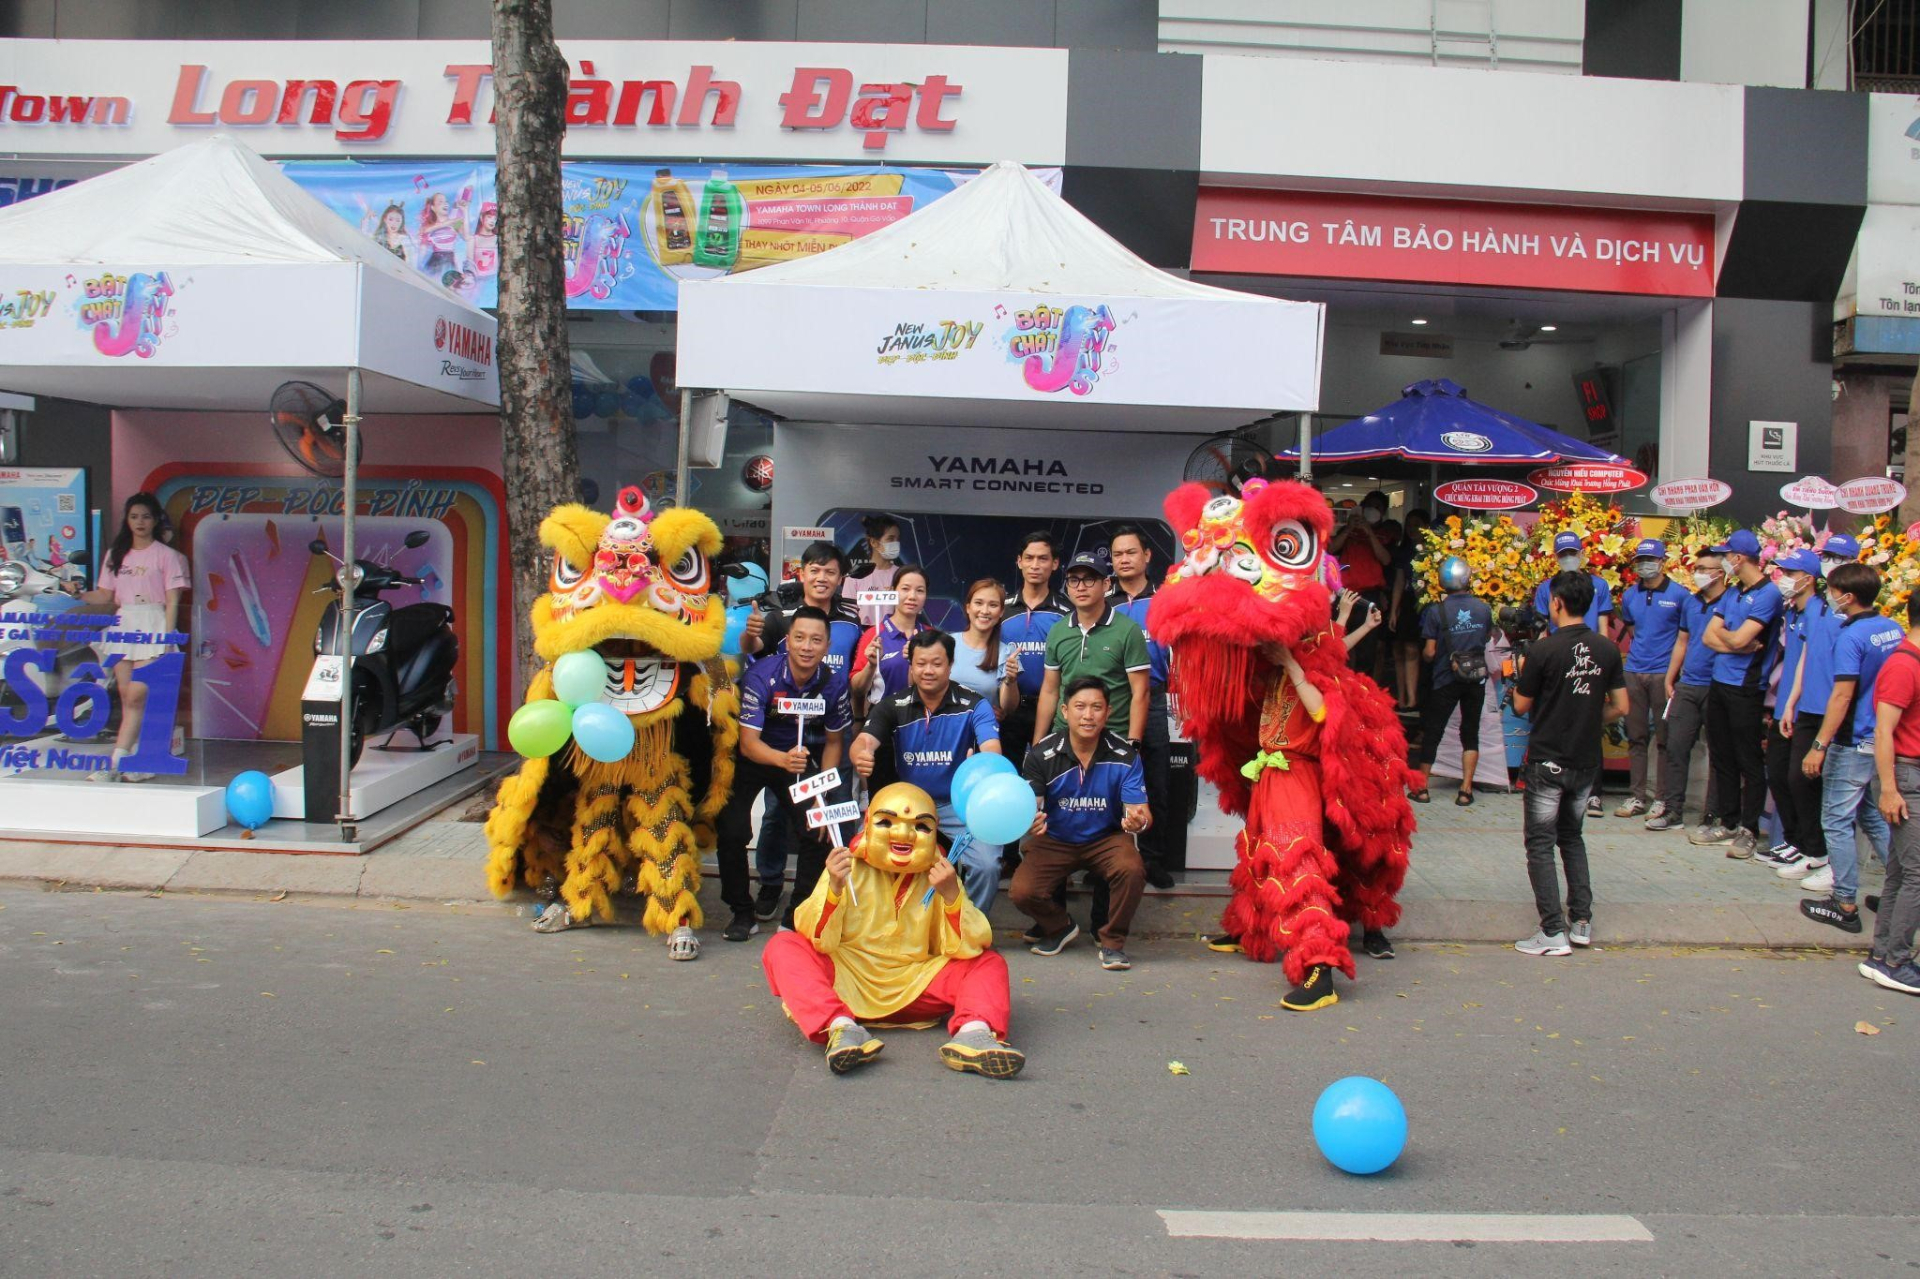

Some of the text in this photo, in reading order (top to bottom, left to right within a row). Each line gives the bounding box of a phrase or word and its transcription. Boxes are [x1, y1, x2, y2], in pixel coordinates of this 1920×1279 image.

[166, 64, 401, 142] Long
[444, 58, 743, 127] Tành
[779, 66, 963, 149] Đạt
[756, 181, 872, 195] NGÀY 04-05/06/2022
[756, 206, 794, 214] YAMAHA
[796, 204, 821, 213] TOWN
[823, 203, 848, 212] LONG
[745, 240, 768, 249] THAY
[1210, 217, 1704, 271] TRUNG TÂM BẢO HÀNH VÀ DỊCH VỤ
[1879, 298, 1900, 311] Tôn
[877, 319, 985, 354] JANUS JOY
[895, 323, 924, 336] NEW
[448, 321, 491, 366] YAMAHA
[928, 455, 1068, 477] YAMAHA
[1590, 470, 1624, 478] COMPUTER
[890, 477, 1104, 494] SMART CONNECTED
[798, 530, 826, 538] YAMAHA
[8, 629, 30, 640] GA
[106, 629, 152, 644] NHIÊN
[1017, 641, 1046, 651] YAMAH
[793, 702, 824, 711] YAMAHA
[118, 653, 188, 775] 1
[312, 714, 338, 722] YAMAHA
[46, 748, 112, 771] Nam
[915, 751, 953, 762] YAMAHA
[812, 772, 836, 788] LTD
[1070, 797, 1107, 808] YAMAHA
[823, 805, 858, 821] YAMAHA
[1810, 906, 1843, 921] BOSTON
